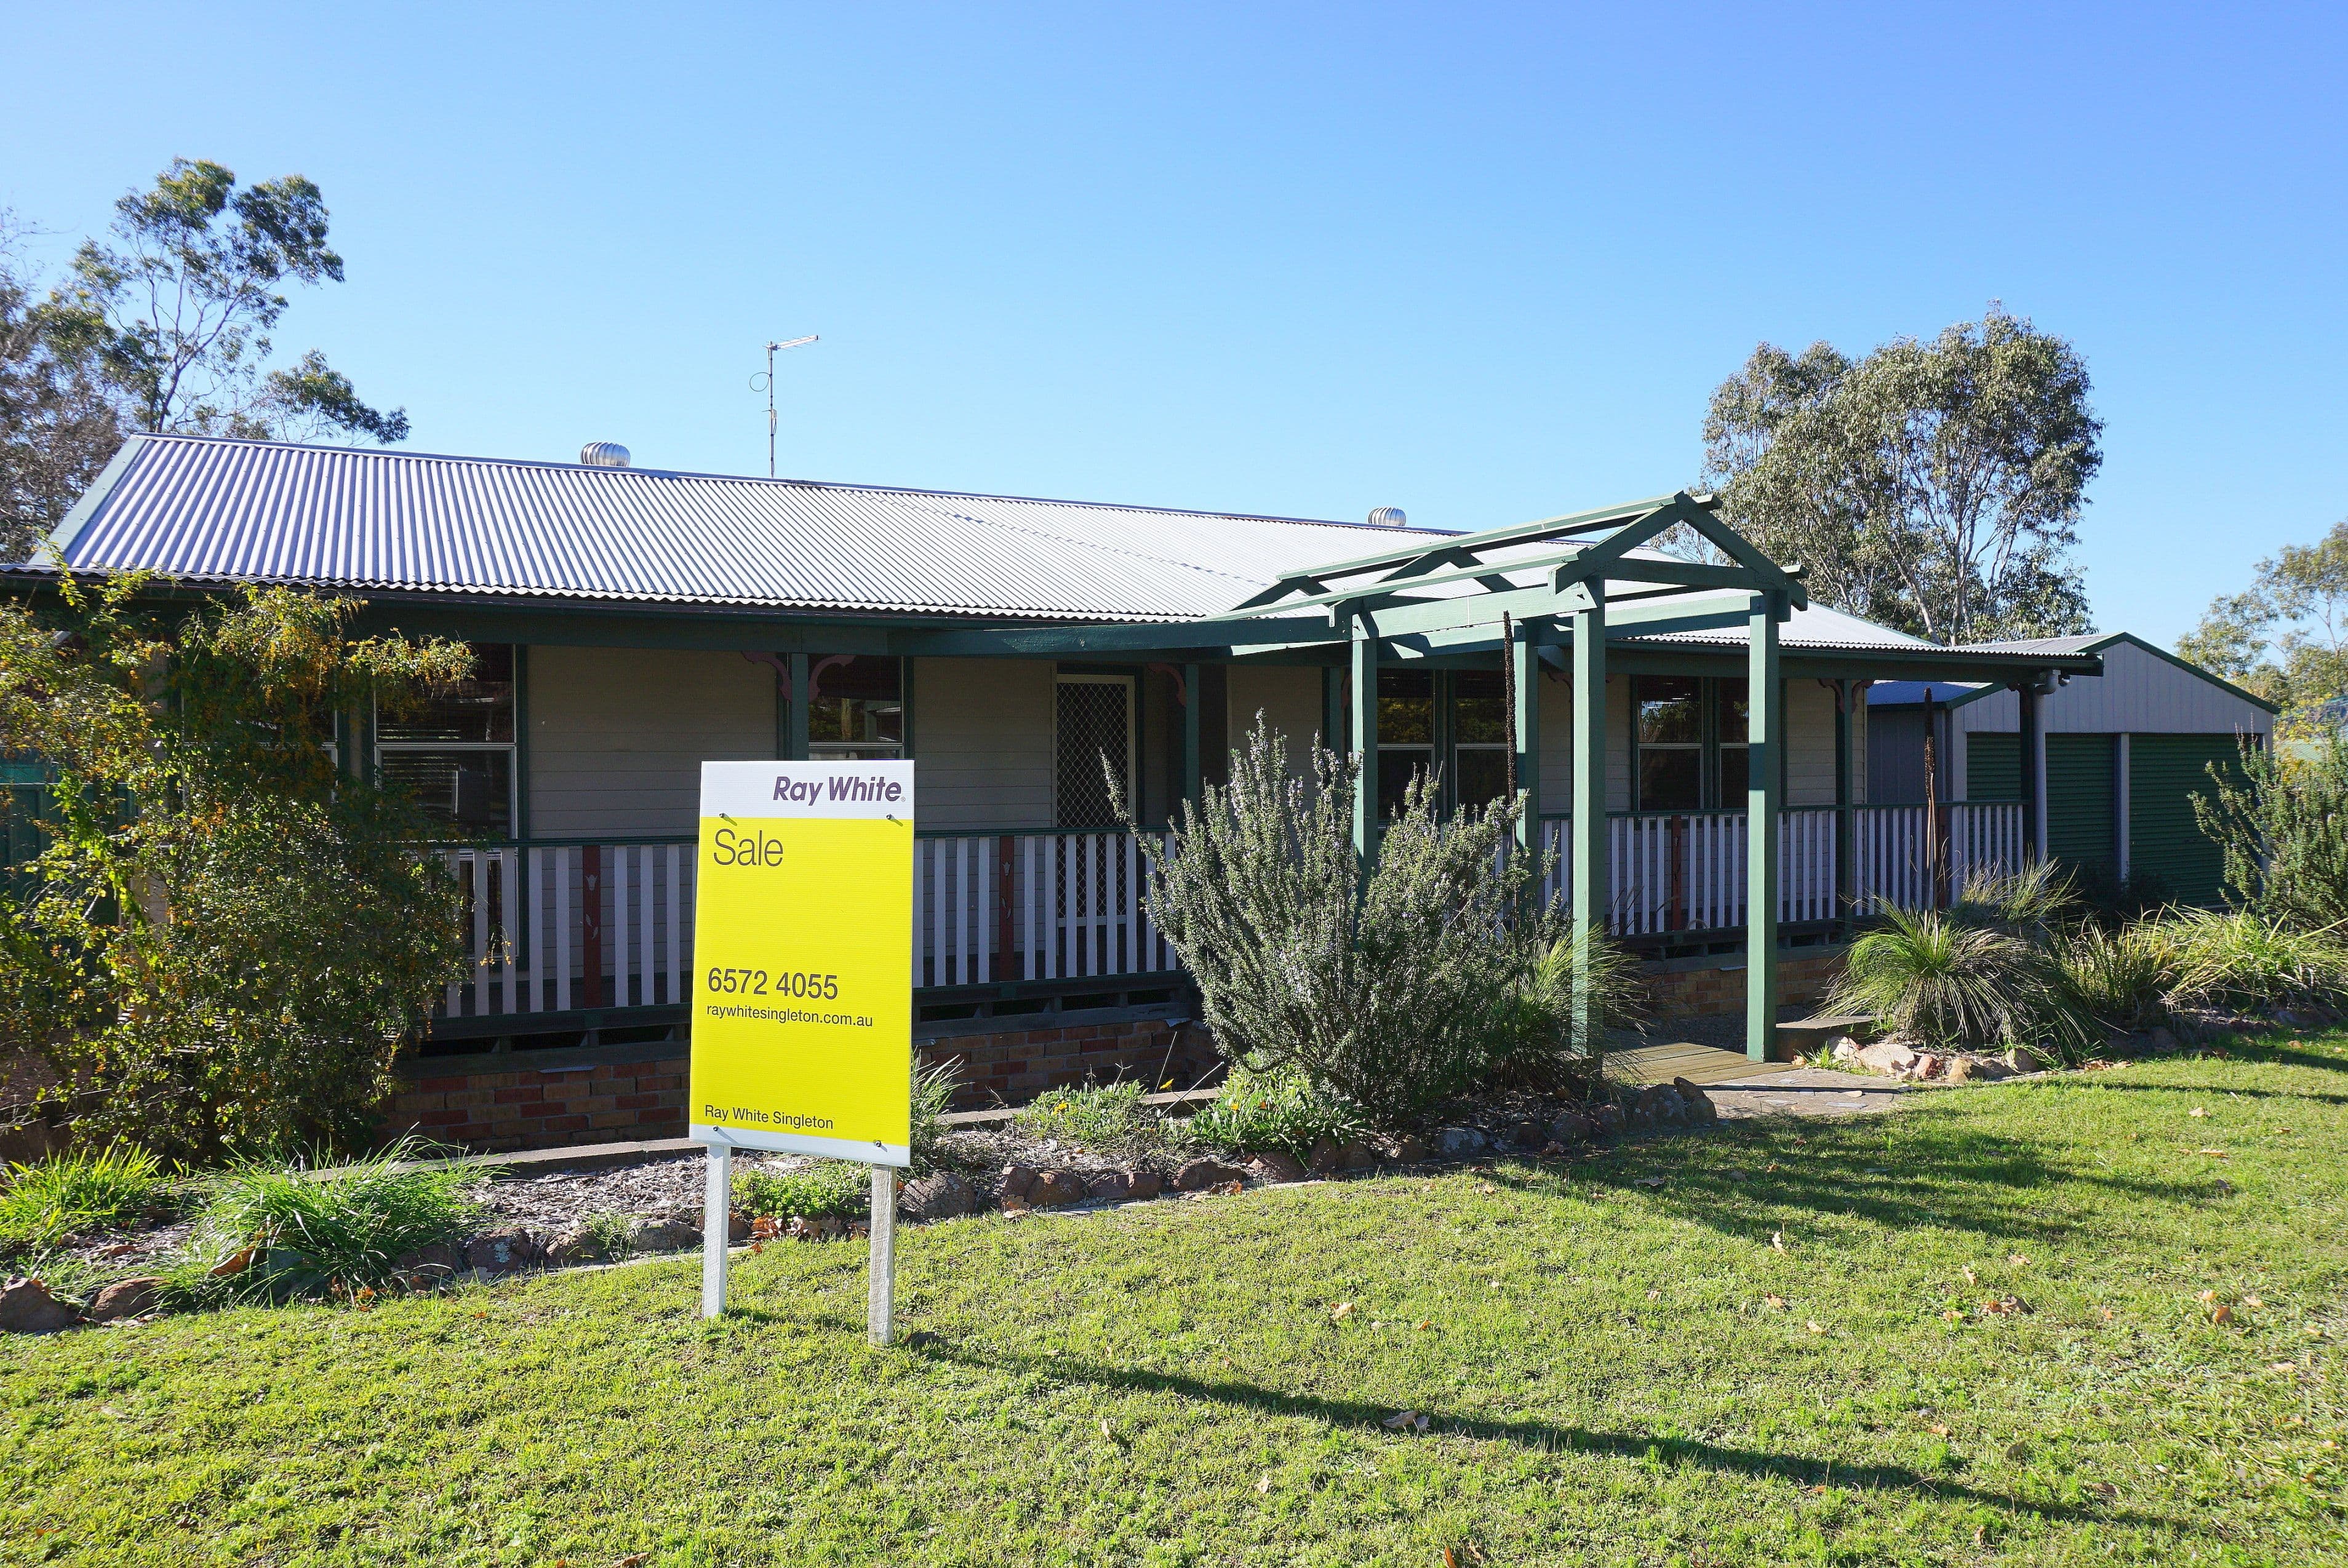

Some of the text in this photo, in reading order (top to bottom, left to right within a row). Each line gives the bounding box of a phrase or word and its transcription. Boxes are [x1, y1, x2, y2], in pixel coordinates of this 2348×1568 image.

[773, 776, 823, 806] Ray
[714, 829, 783, 866] Sale
[708, 968, 838, 1000] 6572 4055
[706, 1005, 873, 1027] raywhitesingleton.com.au
[705, 1105, 834, 1129] Ray White Singleton
